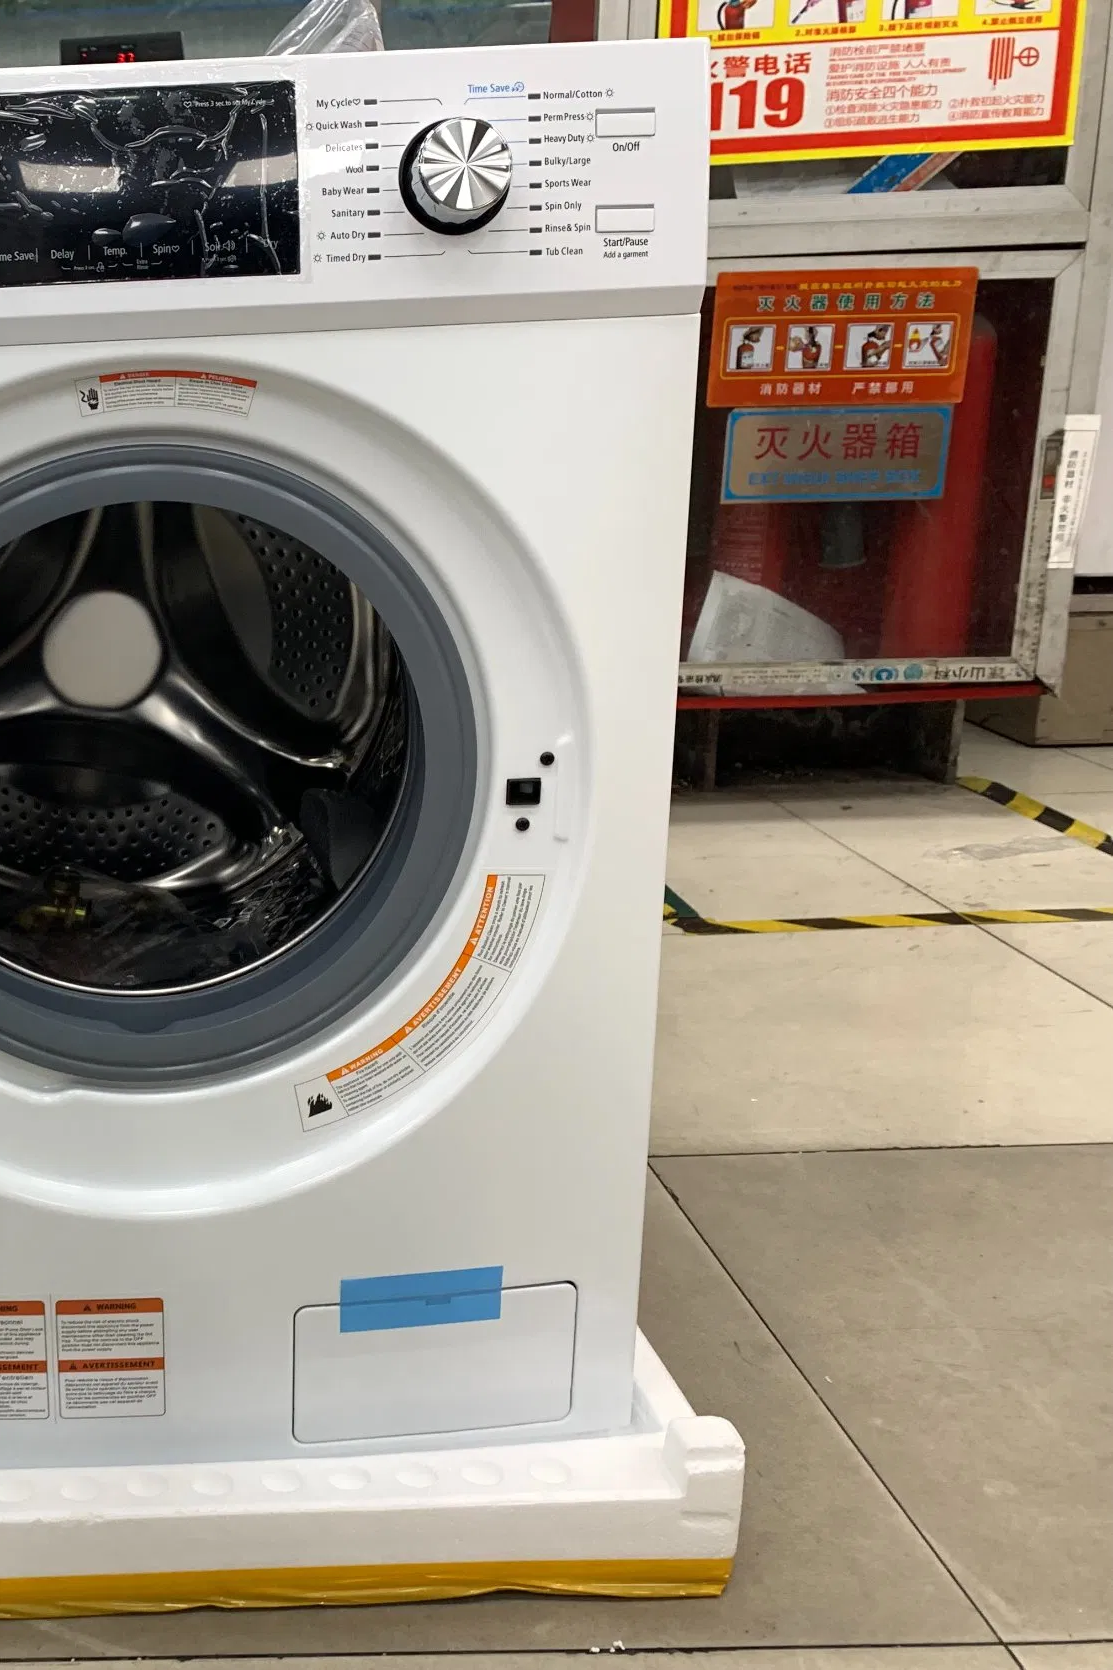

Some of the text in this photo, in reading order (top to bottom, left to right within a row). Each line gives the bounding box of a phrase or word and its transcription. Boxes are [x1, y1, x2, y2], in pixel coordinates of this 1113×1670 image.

[904, 58, 951, 69] 人人有责
[468, 83, 510, 94] Time Save
[826, 85, 938, 102] 消防安全四个能力
[543, 90, 603, 100] Normal/Cotton
[316, 98, 352, 109] My Cycle
[710, 77, 805, 131] 119
[543, 112, 585, 122] Perm Press
[315, 120, 362, 131] Quick Wash
[544, 133, 585, 144] Heavy Duty
[325, 144, 363, 152] Delicates
[612, 142, 640, 152] On/Off
[544, 156, 591, 168] Bulky/Large
[345, 164, 364, 173] Wool
[545, 178, 591, 189] Sports Wear
[322, 186, 364, 197] Baby Wear
[545, 201, 582, 211] Spin Only
[331, 208, 365, 218] Sanitary
[574, 223, 591, 233] Spin
[330, 230, 365, 240] Auto Dry
[603, 237, 649, 247] Start/Pause
[51, 249, 75, 261] Delay
[103, 246, 128, 257] Temp.
[152, 243, 171, 256] Spin
[546, 246, 583, 256] Tub Clean
[603, 251, 616, 259] Add
[623, 250, 649, 259] garment
[14, 251, 35, 261] Save
[326, 253, 366, 263] Timed Dry
[757, 292, 936, 312] 灭火器使用方法
[760, 382, 822, 396] 消防器材
[755, 422, 923, 461] 灭火器箱
[475, 886, 494, 935] ATTENTION
[412, 968, 462, 1026] AVERTISSEMENT
[350, 1048, 384, 1070] WARNING
[96, 1302, 137, 1311] WARNING
[82, 1361, 156, 1370] AVERTISSEMENT
